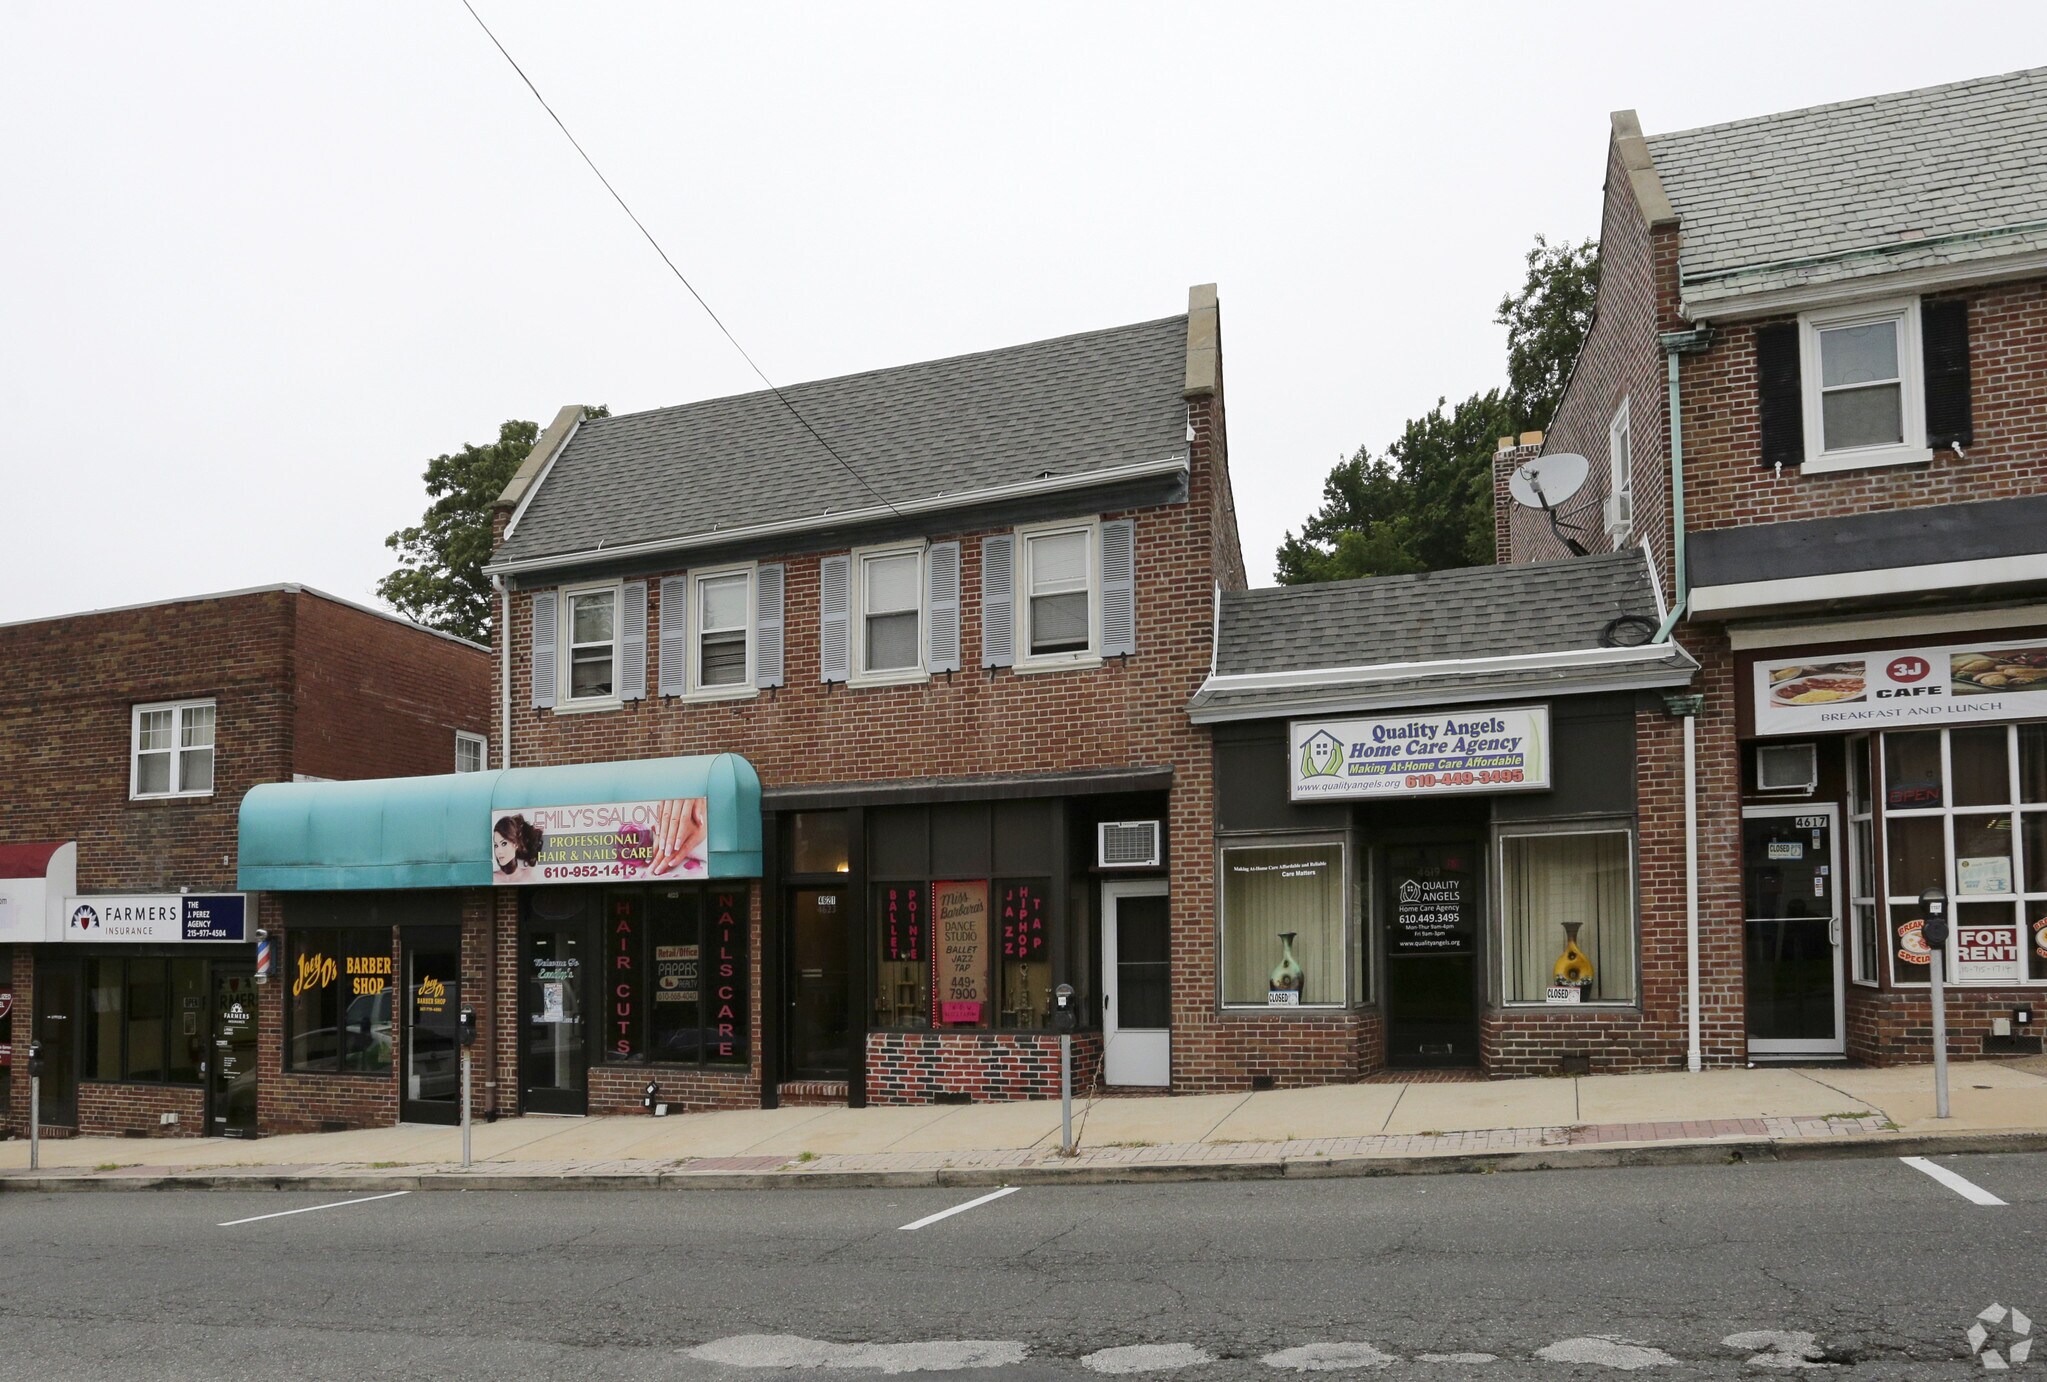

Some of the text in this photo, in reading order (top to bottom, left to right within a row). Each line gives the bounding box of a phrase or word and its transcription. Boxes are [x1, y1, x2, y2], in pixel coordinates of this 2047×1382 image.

[1893, 663, 1922, 677] 3J
[1876, 686, 1942, 699] CAFE
[1821, 702, 2003, 721] BREAKFAST AND LUNCH
[1372, 717, 1505, 743] Quality Angels
[1348, 735, 1522, 759] Home Care Agency
[1349, 755, 1522, 775] Making At-Home Care Affordable
[1297, 779, 1402, 792] www.qualityangels.org
[1405, 768, 1524, 789] 610-449-3495
[1890, 788, 1940, 803] OPEN
[533, 805, 661, 831] EMILY'S SALON
[1796, 817, 1826, 828] 4617
[549, 833, 640, 848] PROFESSIONAL
[537, 846, 653, 863] HAIR & NAILS CARE
[1769, 844, 1790, 853] CLOSED
[544, 864, 637, 879] 610-952-1413
[1422, 881, 1459, 890] QUALITY
[941, 891, 969, 907] Miss
[1422, 891, 1460, 901] ANGELS
[187, 901, 199, 909] THE
[940, 898, 984, 920] Barbara's
[1436, 904, 1459, 912] Agency
[105, 906, 177, 921] FARMERS
[187, 910, 210, 918] J. PEREZ
[1399, 913, 1460, 924] 610.449.3495
[187, 920, 211, 928] AGENCY
[889, 889, 898, 959] BALLET
[908, 889, 918, 959] POINTE
[945, 921, 976, 931] DANCE
[1004, 890, 1014, 954] JAZZ
[1033, 898, 1042, 948] TAP
[105, 926, 153, 936] INSURANCE
[187, 929, 226, 937] 215-977-4504
[944, 931, 977, 941] STUDIO
[1960, 931, 2011, 946] FOR
[946, 945, 978, 954] BALLET
[1958, 946, 2017, 961] RENT
[346, 957, 391, 974] BARBER
[951, 954, 974, 963] JAZZ
[293, 953, 322, 996] Joey
[658, 962, 698, 979] PAPPAS
[718, 895, 734, 1056] NAILS CARE
[955, 964, 971, 972] TAP
[616, 902, 632, 1053] HAIR CUTS
[353, 977, 384, 995] SHOP
[1547, 988, 1568, 998] CLOSED
[949, 988, 977, 1000] 7900
[1269, 993, 1288, 1002] CLOSED
[223, 1012, 249, 1020] FARMERS
